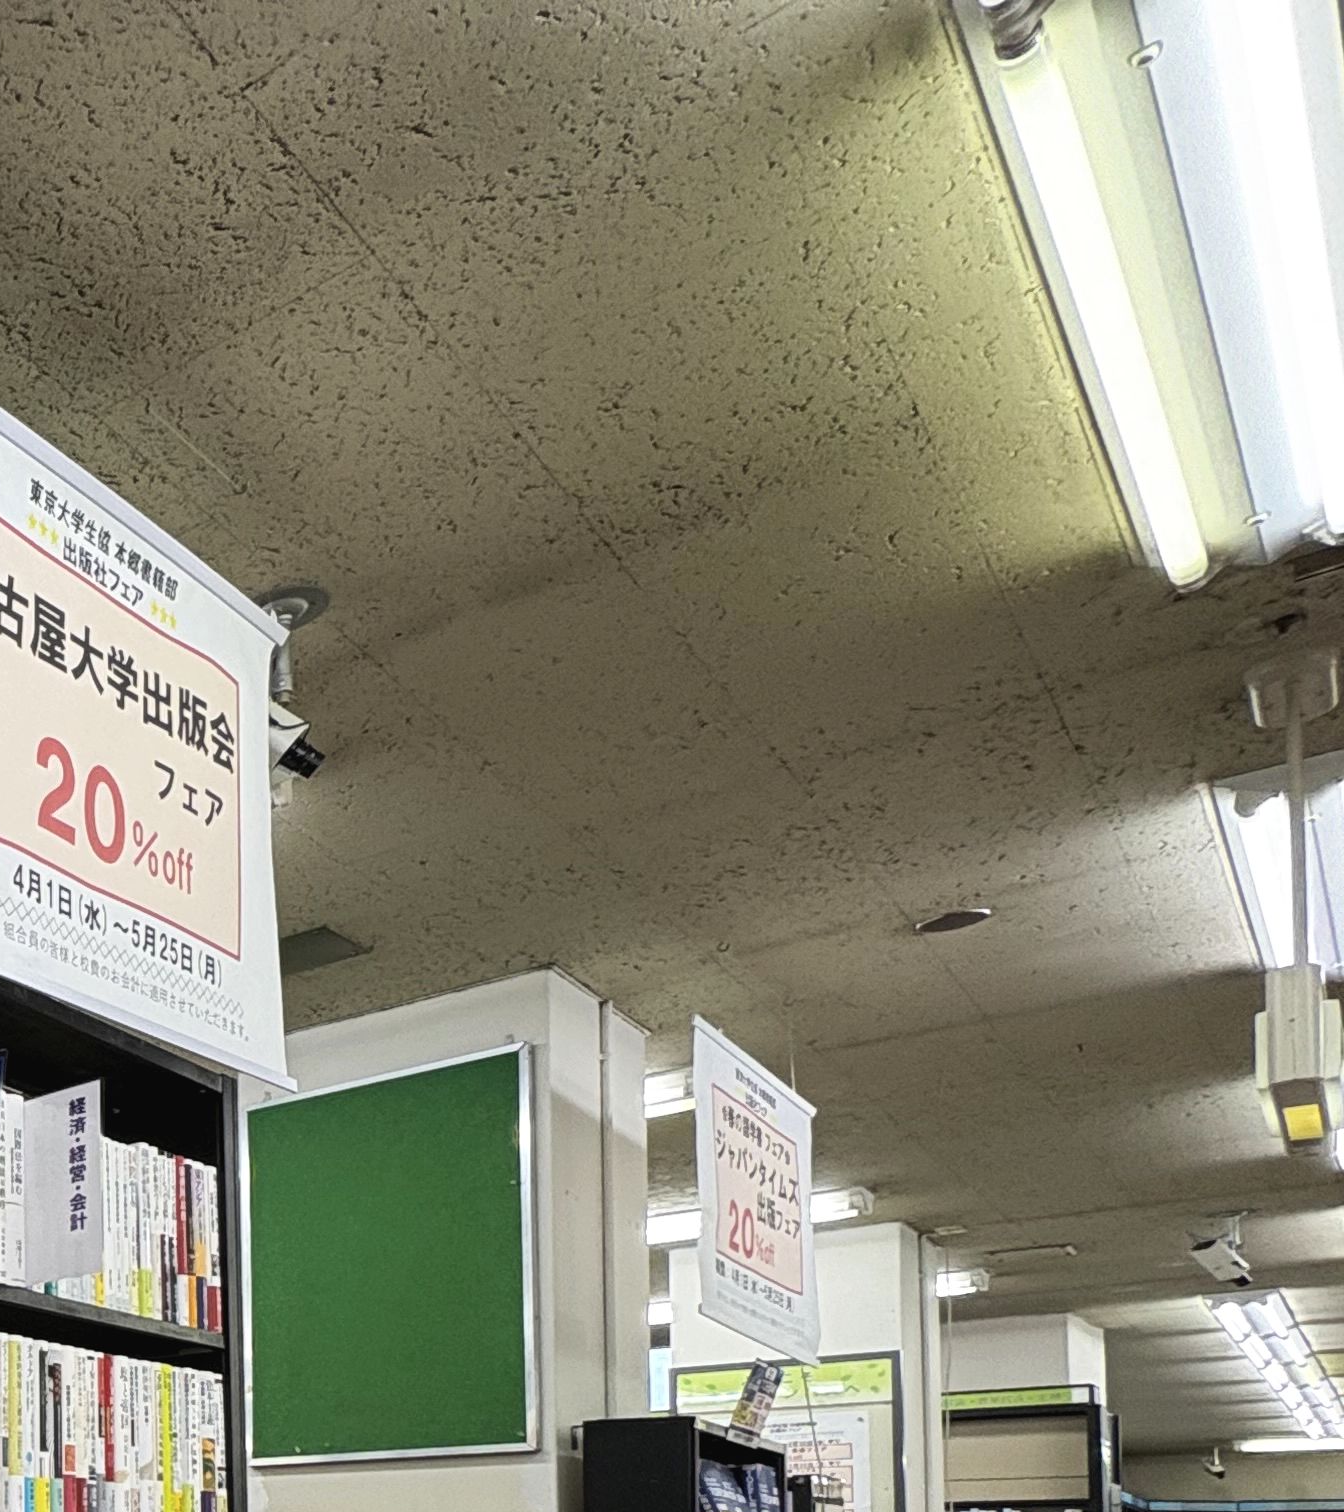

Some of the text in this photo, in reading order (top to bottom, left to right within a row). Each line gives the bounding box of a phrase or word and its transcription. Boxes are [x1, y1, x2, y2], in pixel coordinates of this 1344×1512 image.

[30, 478, 178, 602] 東京大学生協 本郷書籍部
[62, 536, 145, 607] 出版社フェア
[37, 736, 193, 895] 20%off
[154, 760, 223, 827] フェア
[68, 1096, 87, 1231] 経済・経営・会計
[716, 1129, 799, 1206] ジャパンタイムズ
[757, 1191, 799, 1241] 出版フェア
